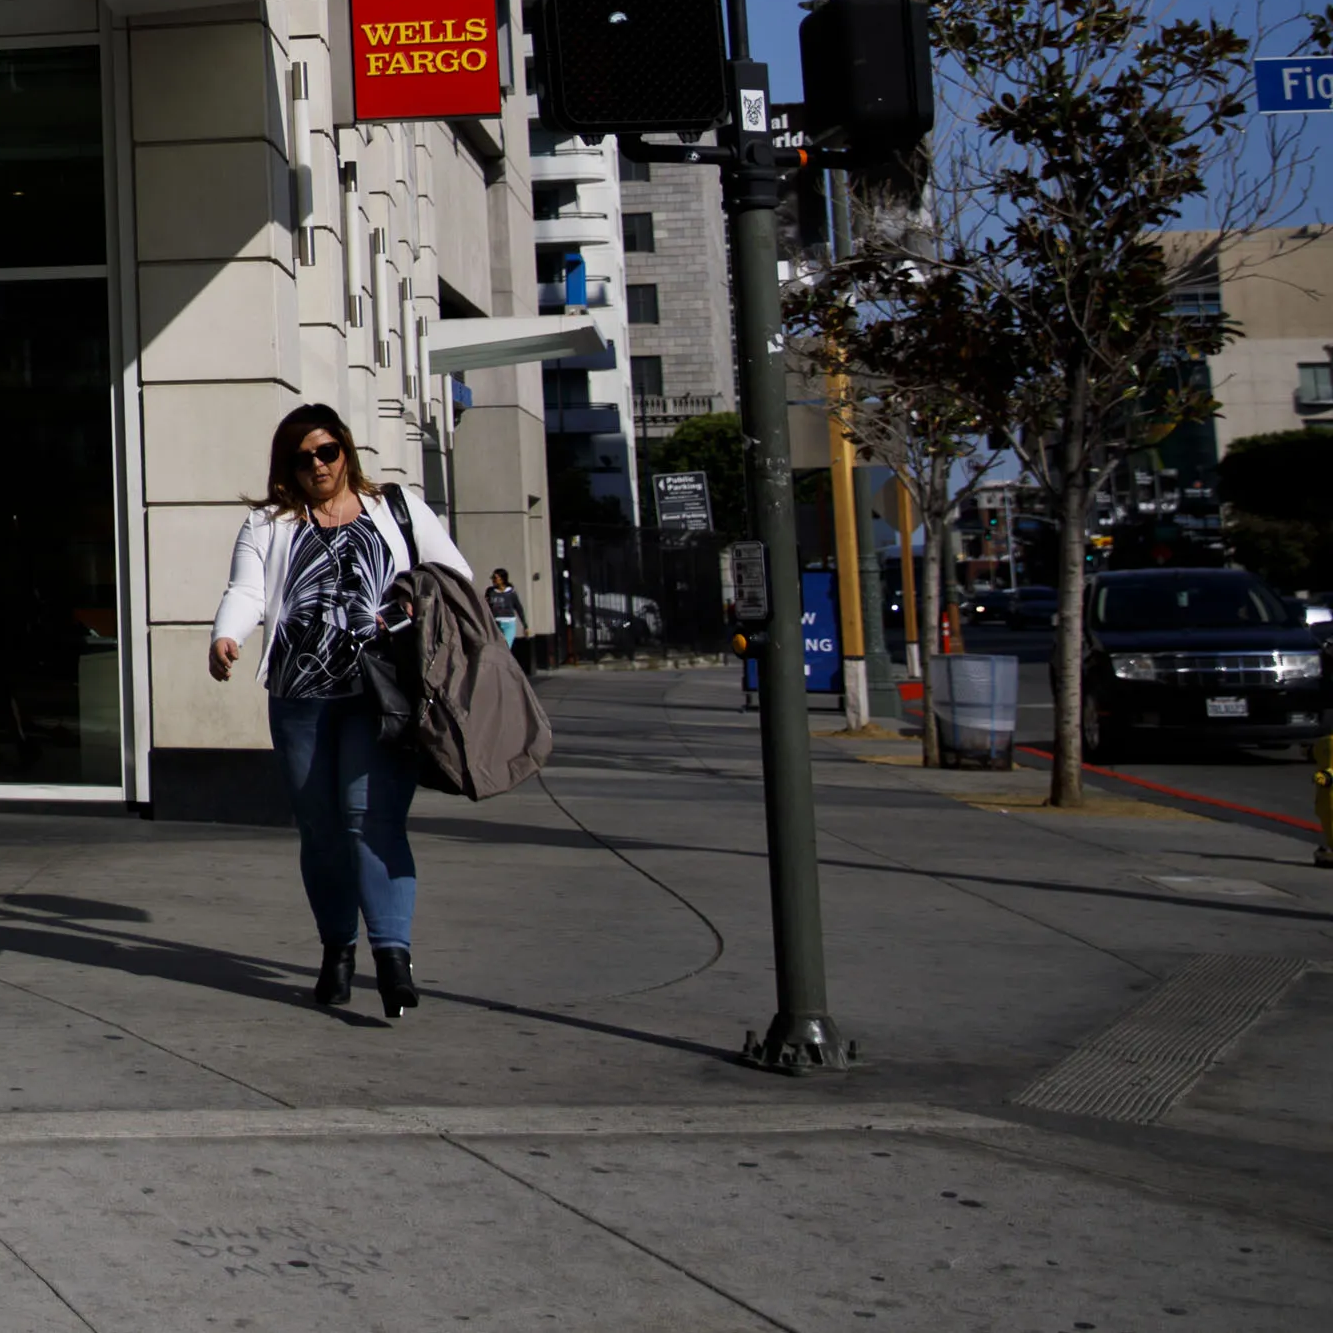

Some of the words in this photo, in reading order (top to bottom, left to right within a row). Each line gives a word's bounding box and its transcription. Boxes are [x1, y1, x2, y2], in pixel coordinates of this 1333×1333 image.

[360, 17, 488, 46] WELLS
[365, 47, 488, 76] FARGO
[665, 476, 695, 484] Public
[667, 483, 703, 491] Parking
